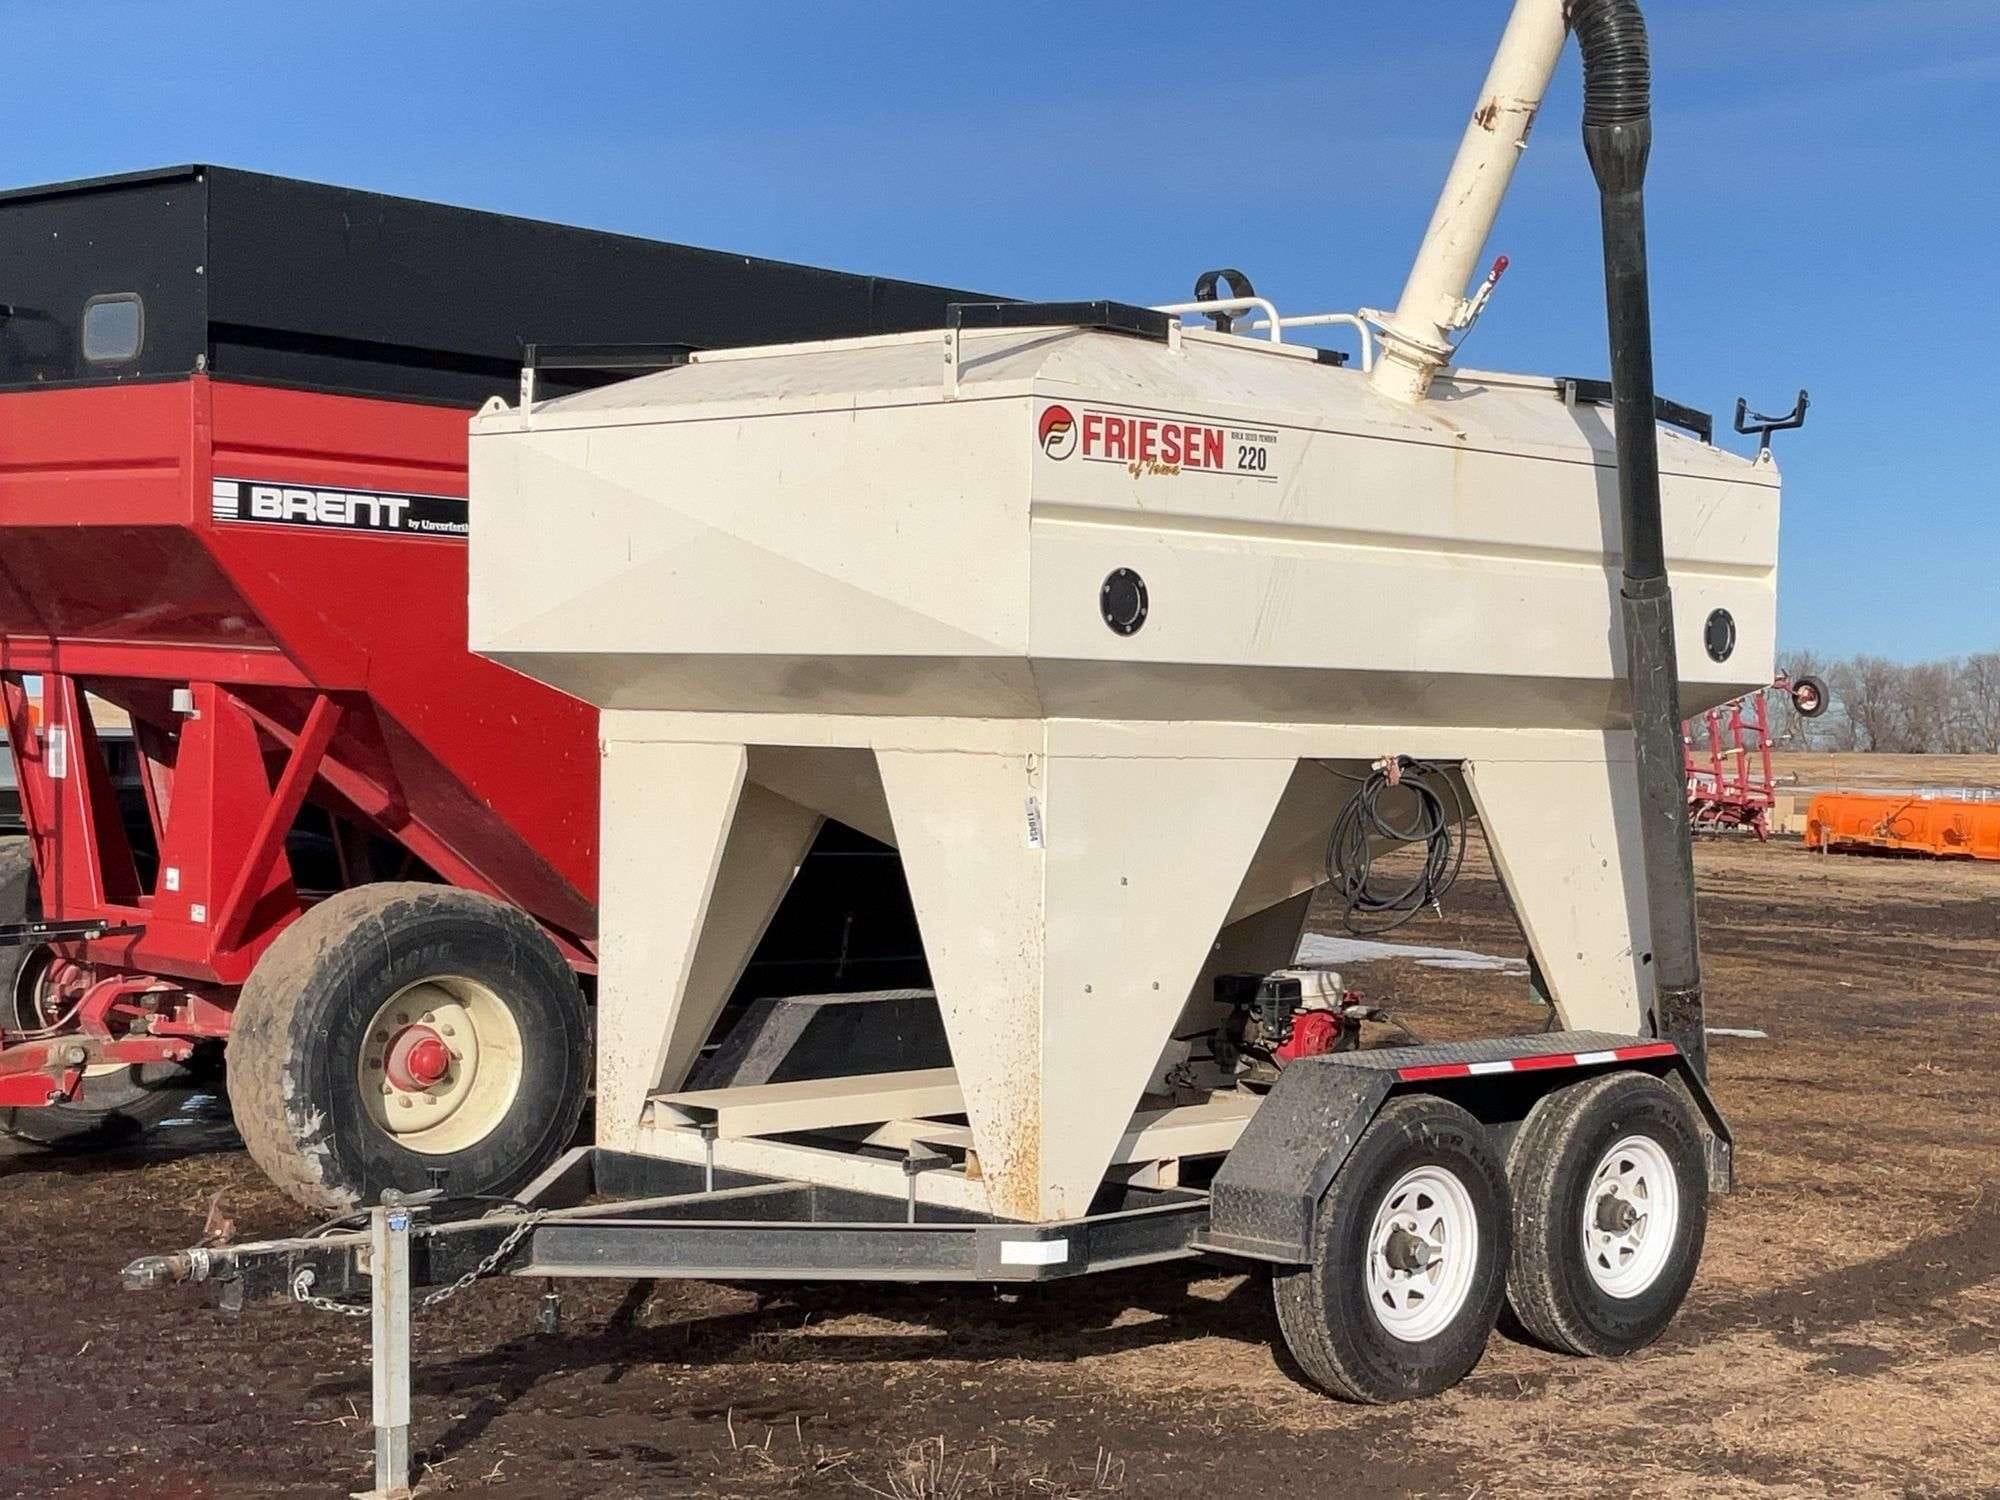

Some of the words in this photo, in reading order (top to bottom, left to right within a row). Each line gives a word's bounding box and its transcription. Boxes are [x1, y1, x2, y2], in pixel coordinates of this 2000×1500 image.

[1083, 414, 1225, 469] FRIESEN
[1238, 446, 1266, 471] 220
[251, 486, 410, 527] BRENT
[408, 519, 420, 530] by
